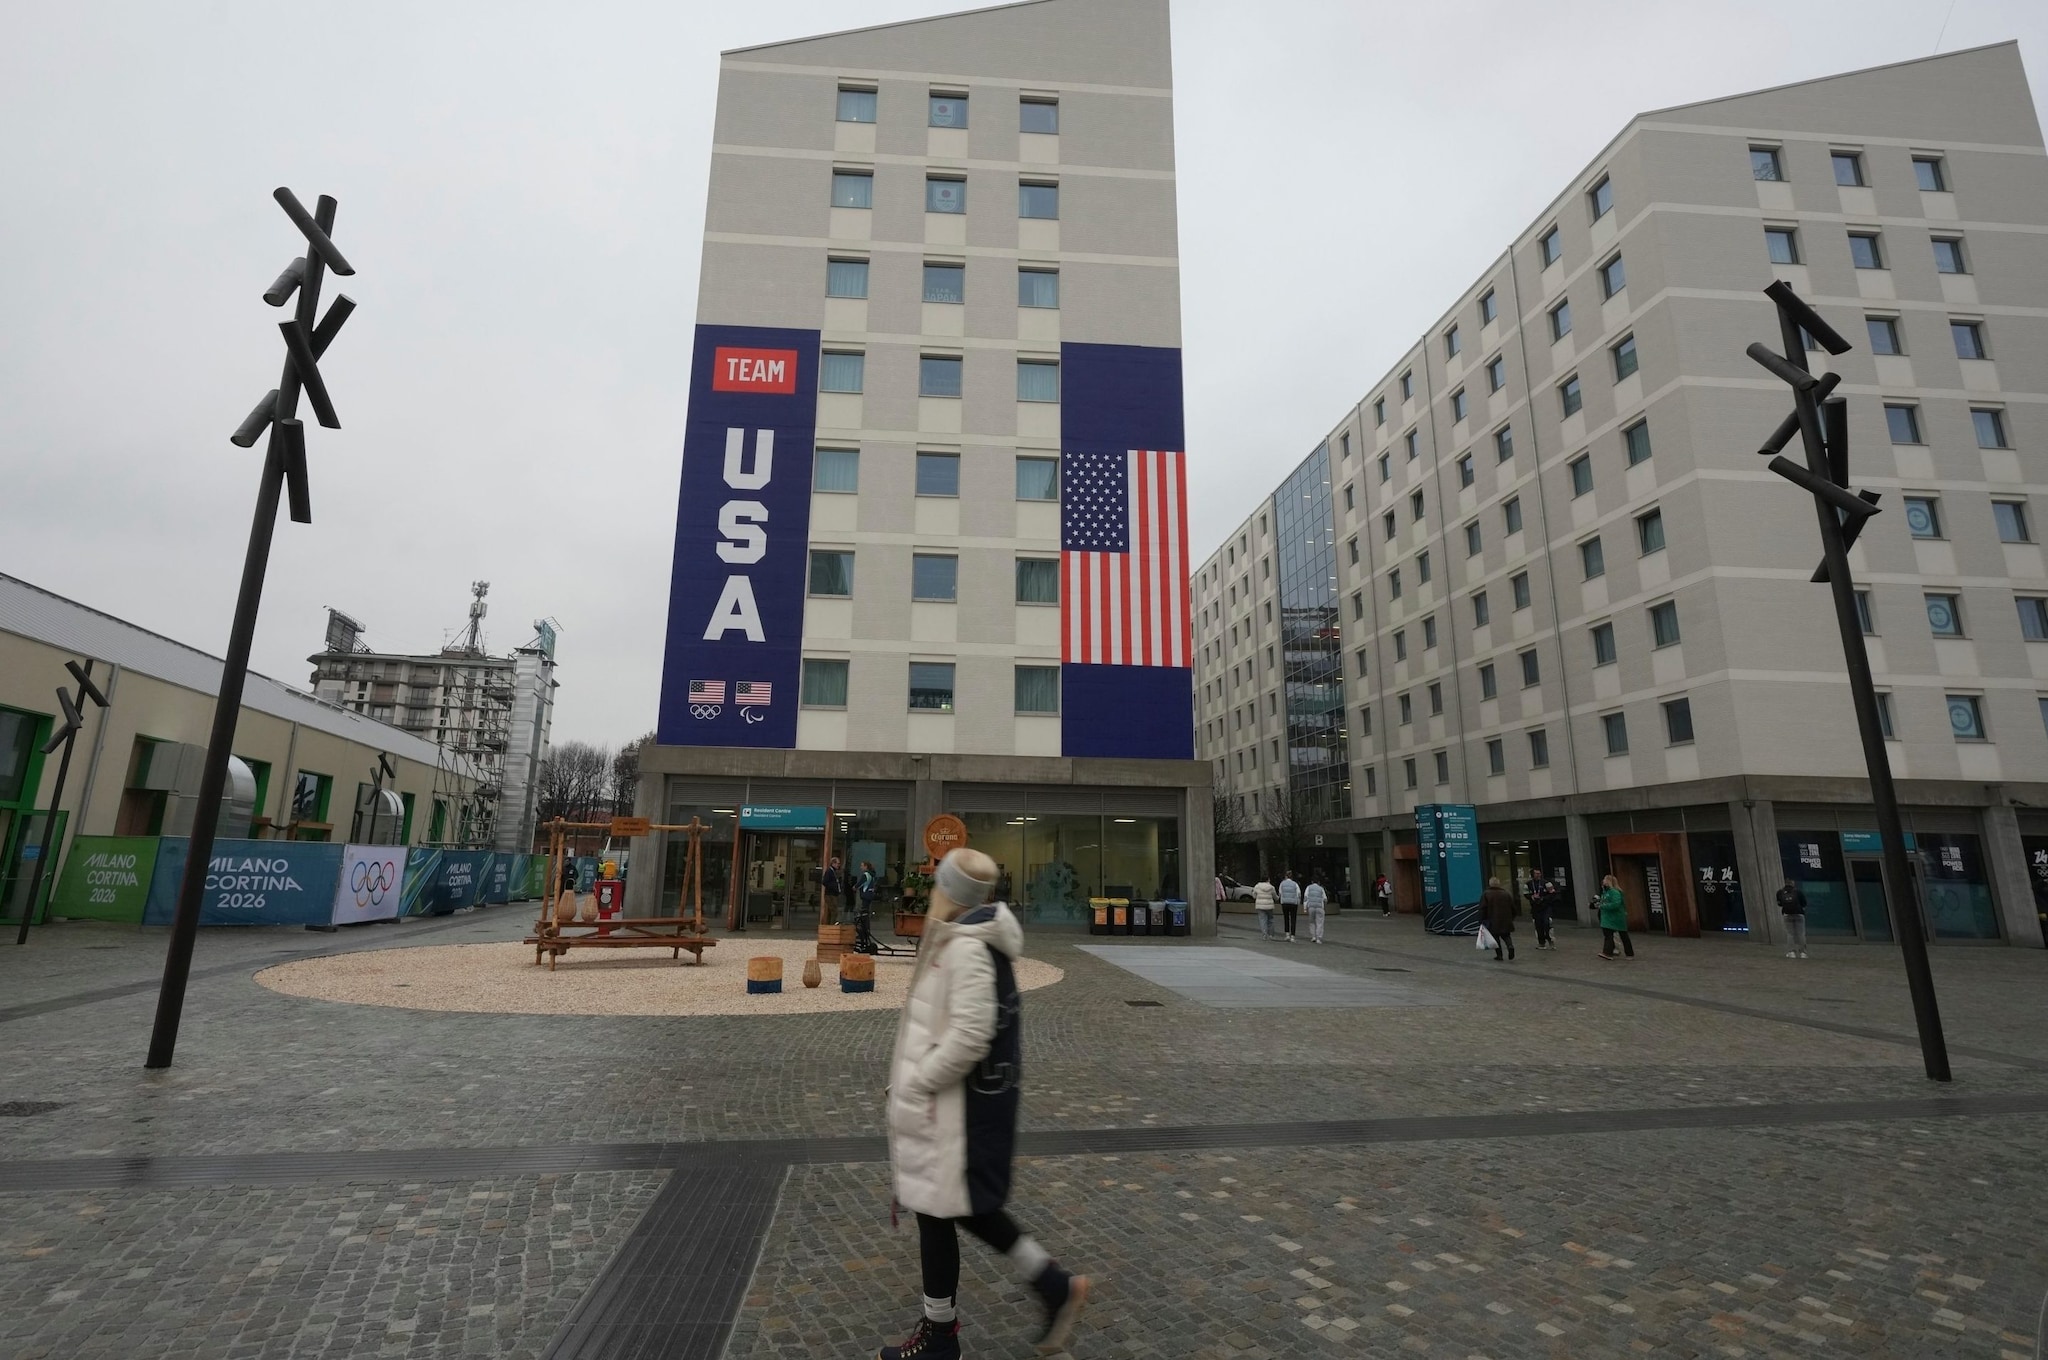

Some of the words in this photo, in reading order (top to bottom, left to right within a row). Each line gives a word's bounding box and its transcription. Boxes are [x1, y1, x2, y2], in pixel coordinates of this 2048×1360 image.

[727, 358, 784, 383] TEAM
[703, 427, 774, 642] USA
[930, 832, 958, 842] Corona
[1314, 834, 1324, 846] B
[83, 853, 136, 868] MILANO
[446, 863, 472, 874] MILANO
[87, 870, 138, 887] CORTINA
[204, 875, 303, 891] CORTINA
[448, 874, 472, 887] CORTINA
[89, 888, 116, 903] 2026
[1646, 866, 1663, 914] WELCOME
[217, 893, 266, 908] 2026
